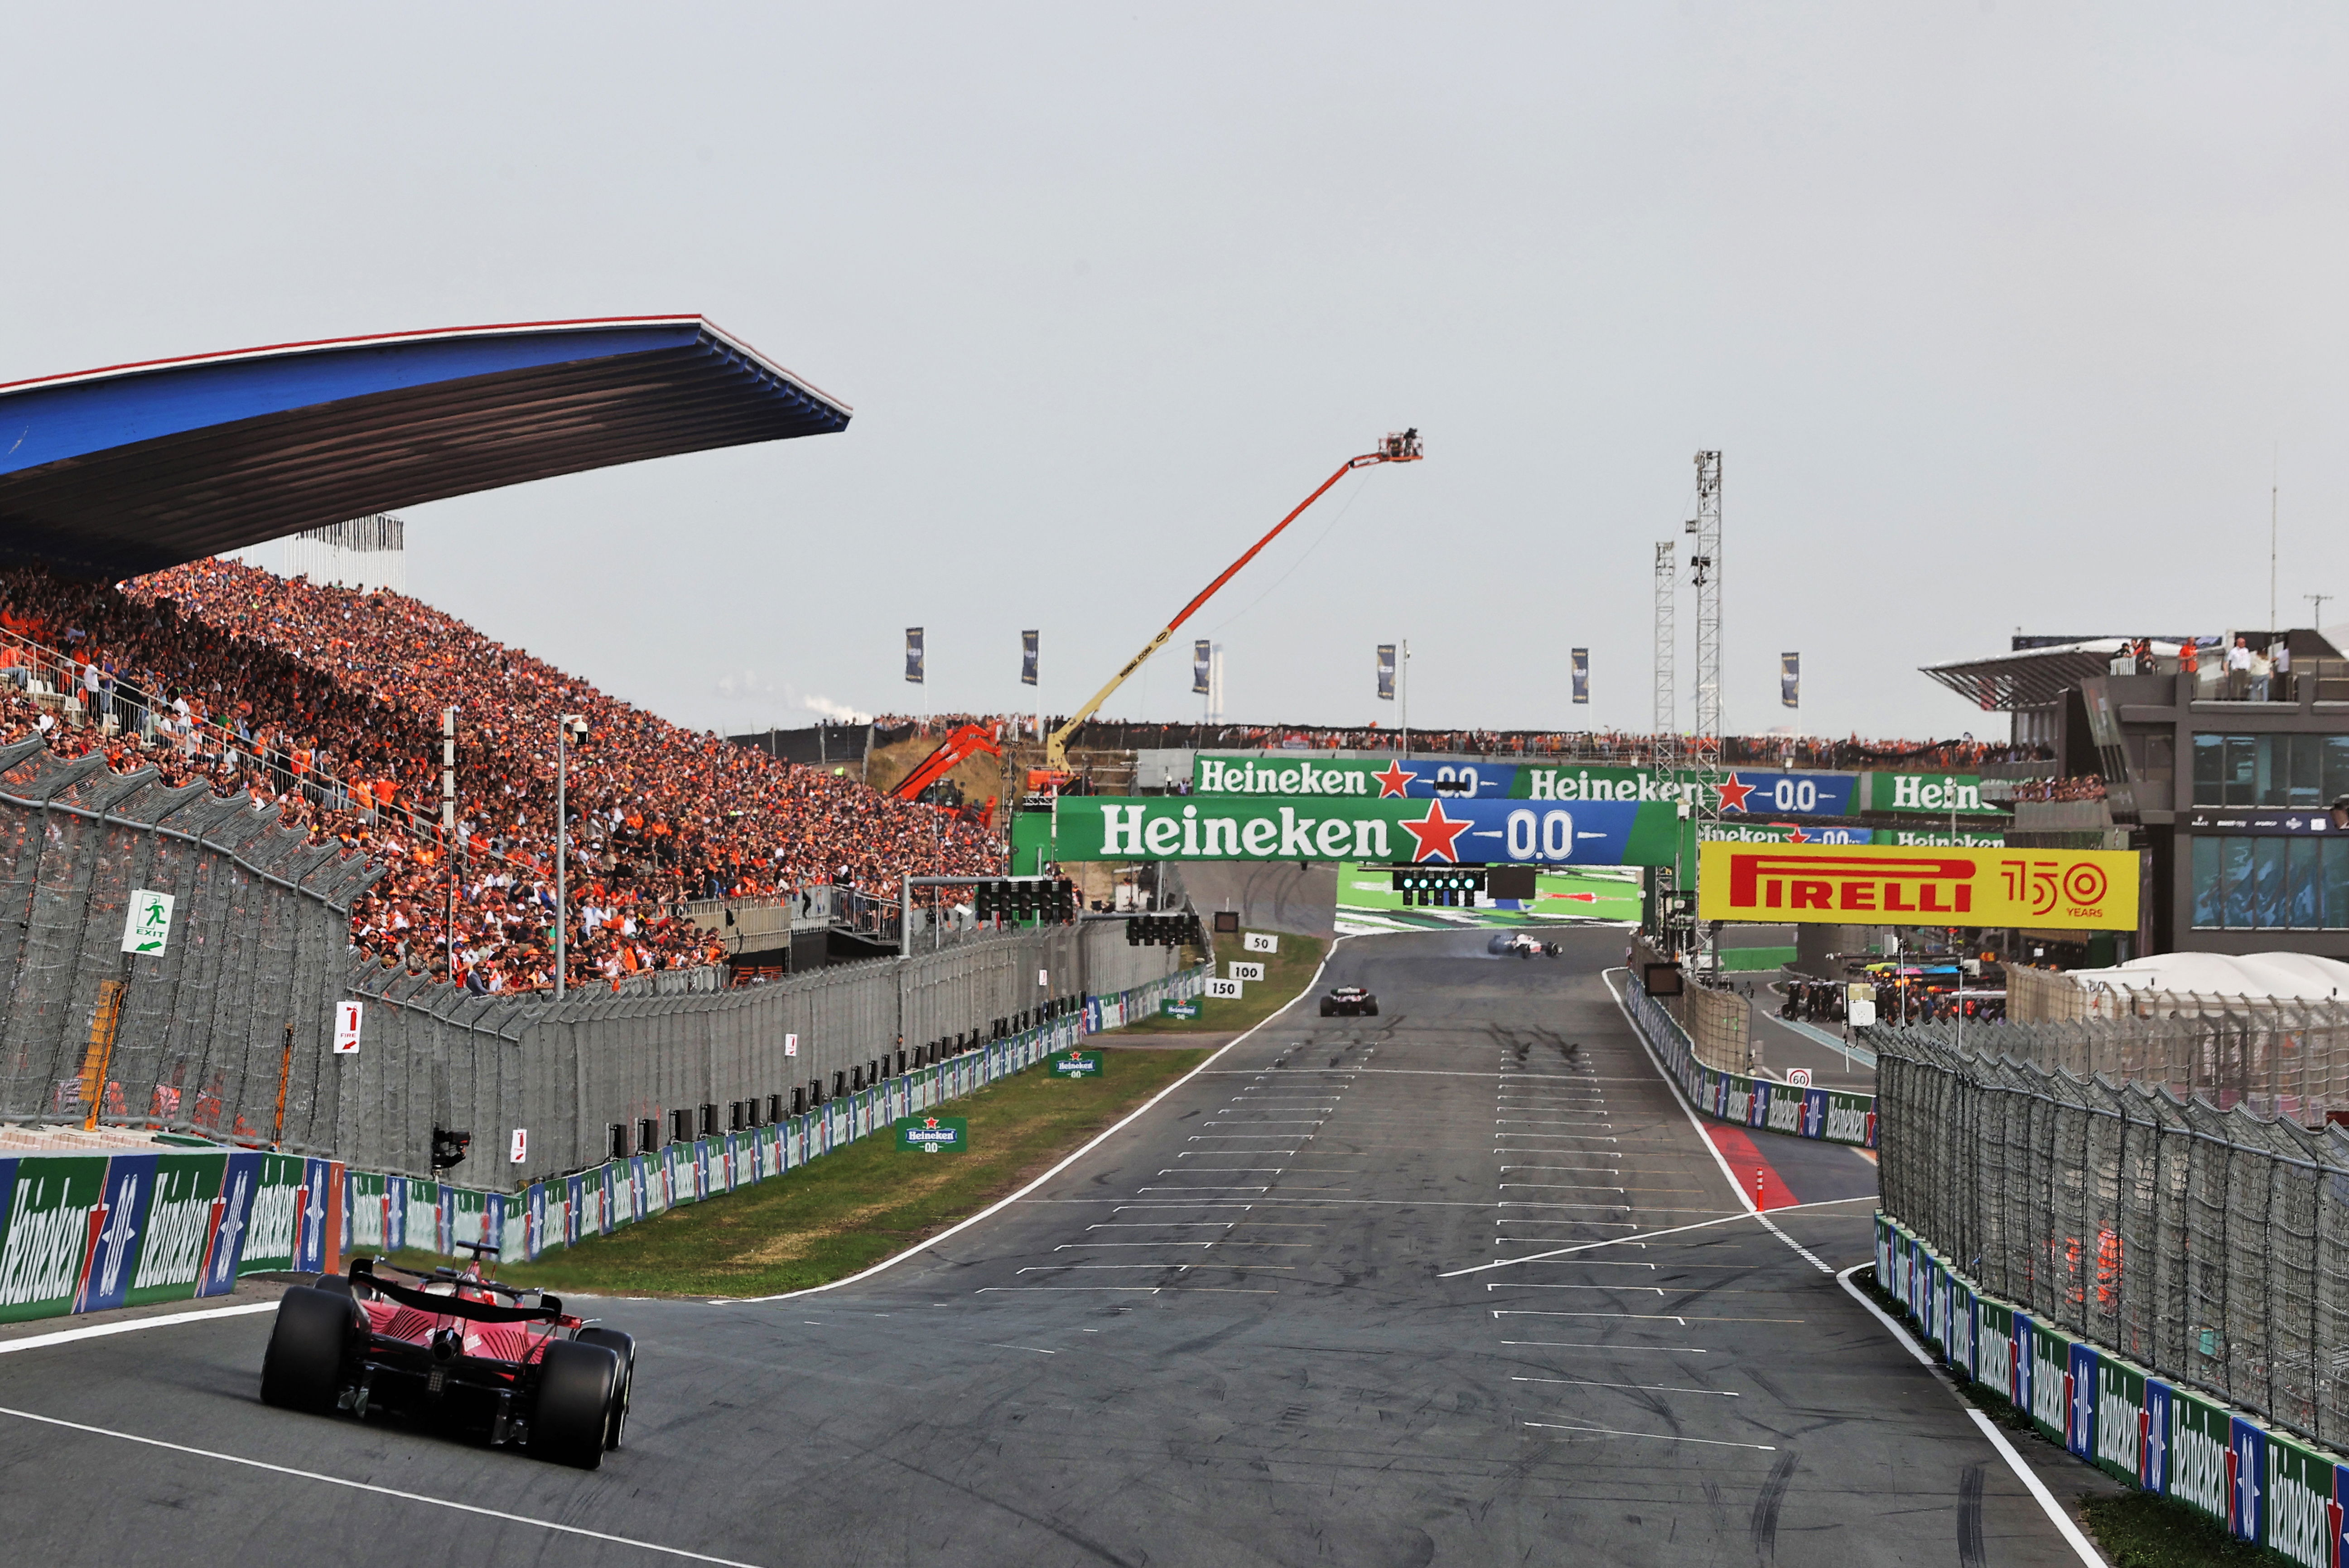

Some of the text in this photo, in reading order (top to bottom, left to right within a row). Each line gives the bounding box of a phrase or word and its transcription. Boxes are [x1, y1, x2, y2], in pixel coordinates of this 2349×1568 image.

[1200, 760, 1367, 794] Heineken
[1529, 769, 1706, 806] Heineken
[1775, 779, 1816, 811] 0.0
[1100, 804, 1573, 860] Heineken 0.0
[1730, 854, 2107, 915] PIRELLI 150
[2066, 908, 2103, 917] YEARS
[136, 929, 164, 937] EXIT
[1254, 938, 1268, 949] 50
[1236, 967, 1258, 978] 100
[1213, 983, 1235, 994] 150
[1793, 1076, 1806, 1084] 60
[1826, 1095, 1865, 1142] Heineken
[908, 1131, 954, 1140] Heineken
[241, 1158, 296, 1261] eineken
[2098, 1367, 2138, 1475] Heineken
[2171, 1399, 2225, 1519] Heineken
[2269, 1444, 2327, 1568] Heineken
